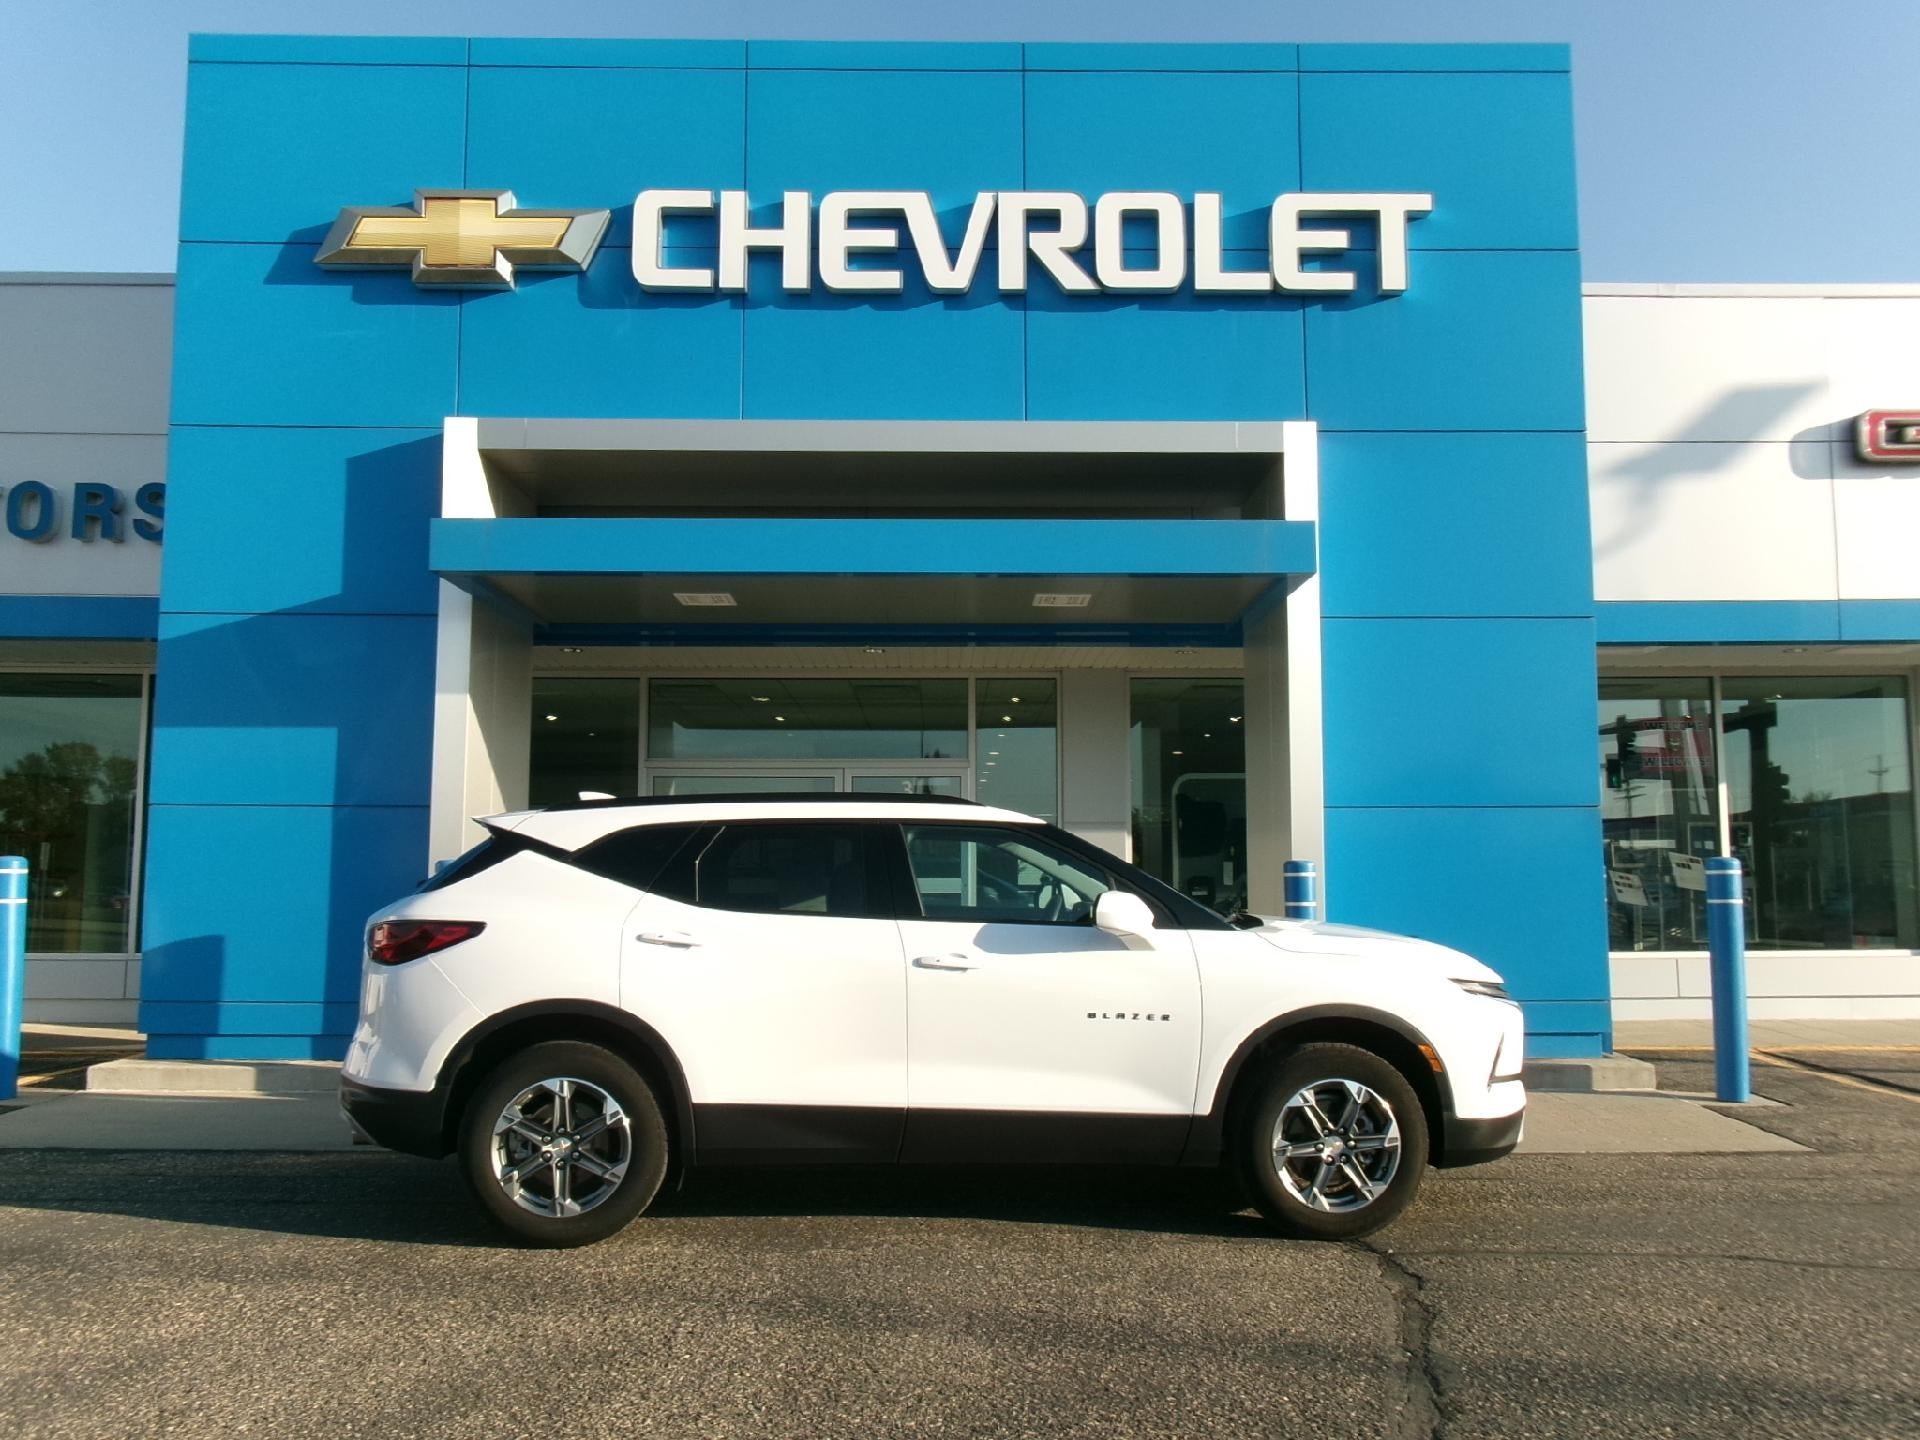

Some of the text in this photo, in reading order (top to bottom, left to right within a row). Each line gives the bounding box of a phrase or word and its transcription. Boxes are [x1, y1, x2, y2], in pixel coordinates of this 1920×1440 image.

[632, 190, 1433, 294] CHEVROLET
[0, 480, 166, 544] ORS
[1087, 1012, 1170, 1021] BLAZER
